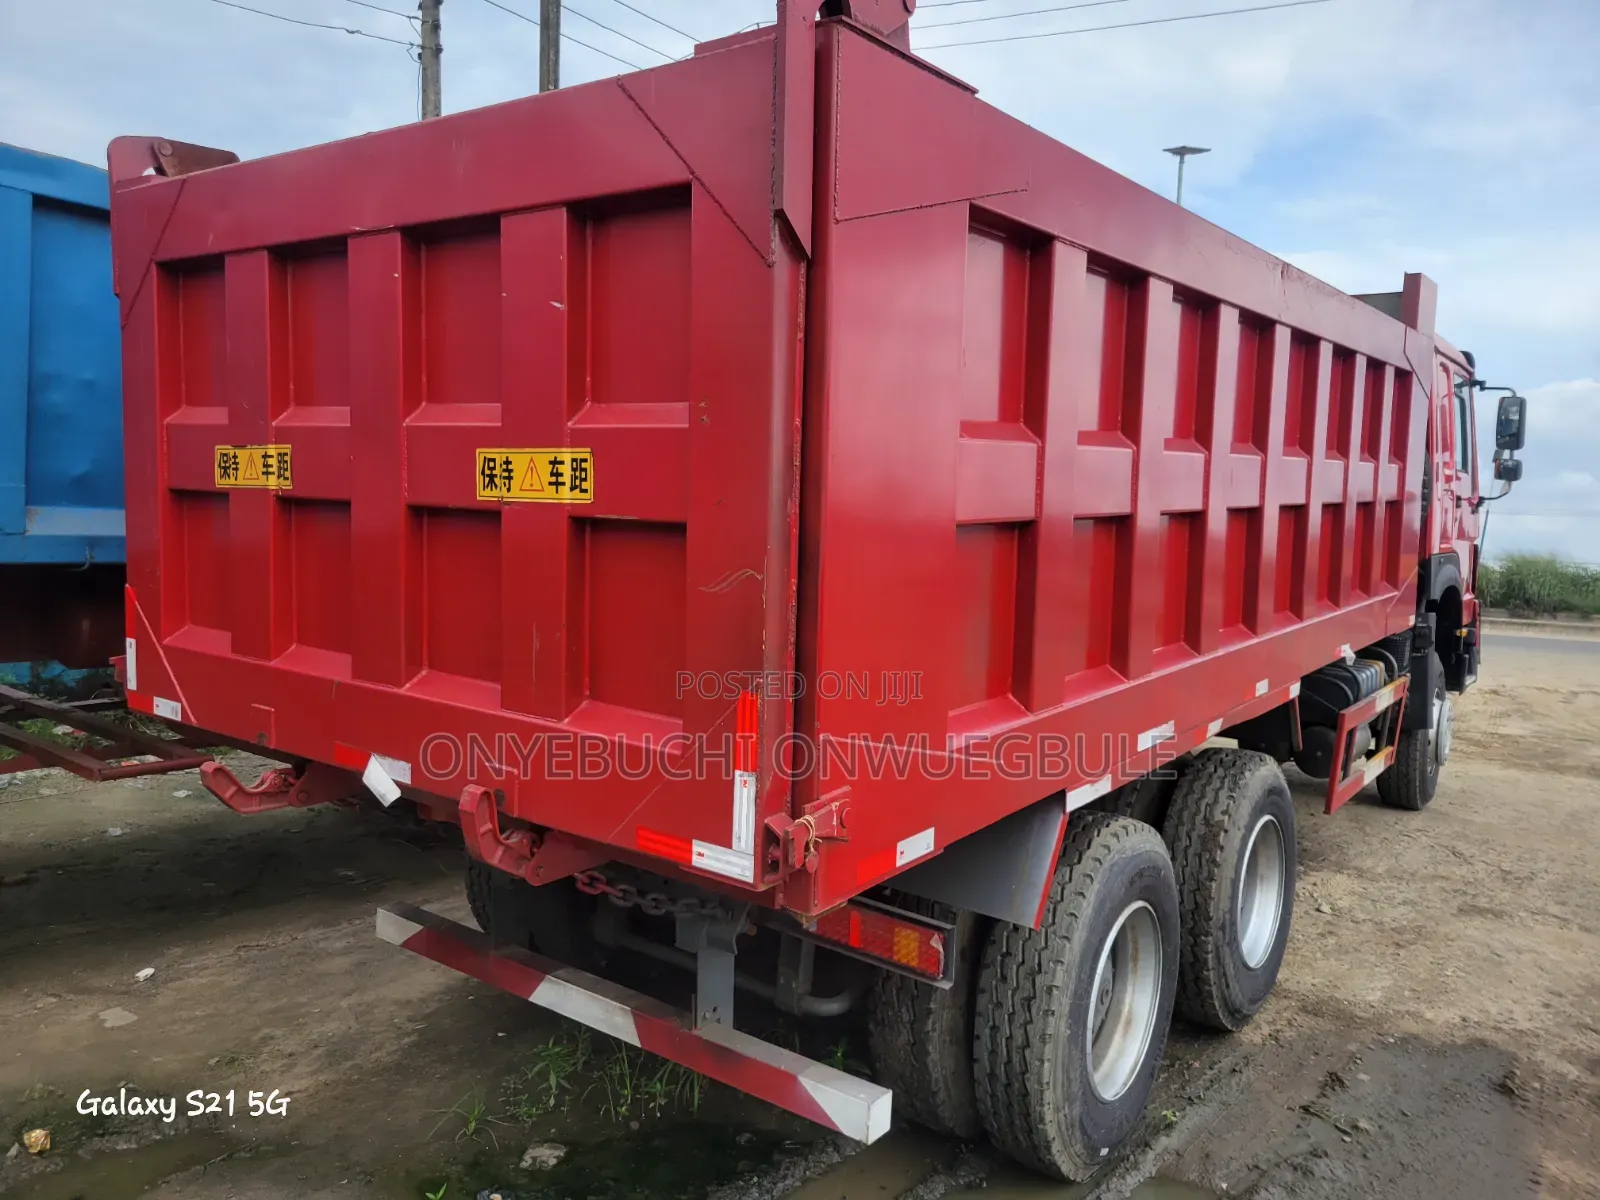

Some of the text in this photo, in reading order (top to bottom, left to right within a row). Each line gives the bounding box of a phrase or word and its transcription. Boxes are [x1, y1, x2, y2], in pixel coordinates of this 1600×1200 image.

[261, 451, 290, 481] 车距
[481, 456, 589, 494] 保持 车距
